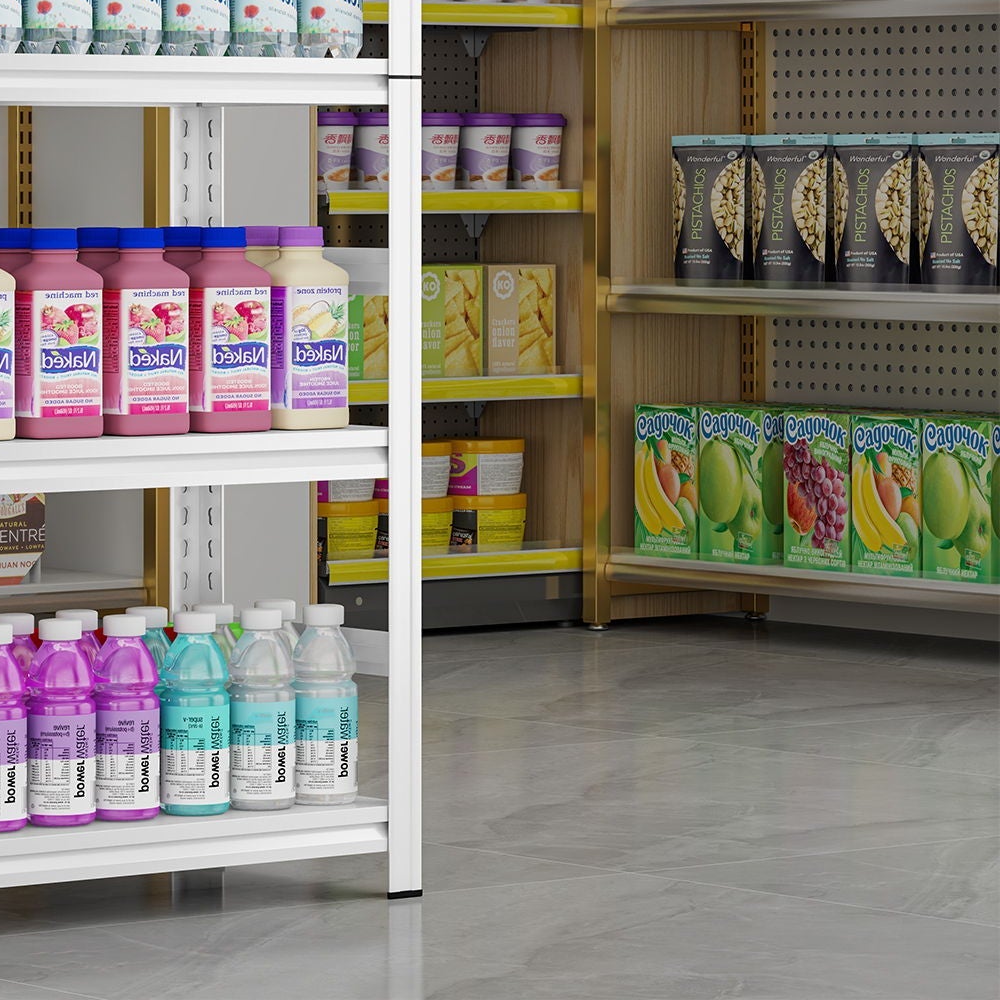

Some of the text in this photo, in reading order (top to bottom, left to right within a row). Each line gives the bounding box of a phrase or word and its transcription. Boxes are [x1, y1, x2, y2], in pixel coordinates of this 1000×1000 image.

[687, 155, 725, 163] Wonderful
[767, 155, 807, 163] Wonderful
[849, 154, 891, 163] Wonderful
[935, 154, 978, 163] Wonderful
[692, 168, 706, 240] PISTACHIOS
[772, 168, 786, 241] PISTACHIOS
[855, 168, 870, 242] PISTACHIOS
[941, 168, 956, 244] PISTACHIOS
[497, 279, 510, 289] KO
[492, 327, 515, 336] onion
[492, 337, 515, 347] flavor
[636, 411, 694, 441] Садочок
[701, 411, 760, 445] Садочок
[785, 415, 848, 449] Садочок
[853, 423, 917, 454] Садочок
[924, 423, 990, 458] Садочок
